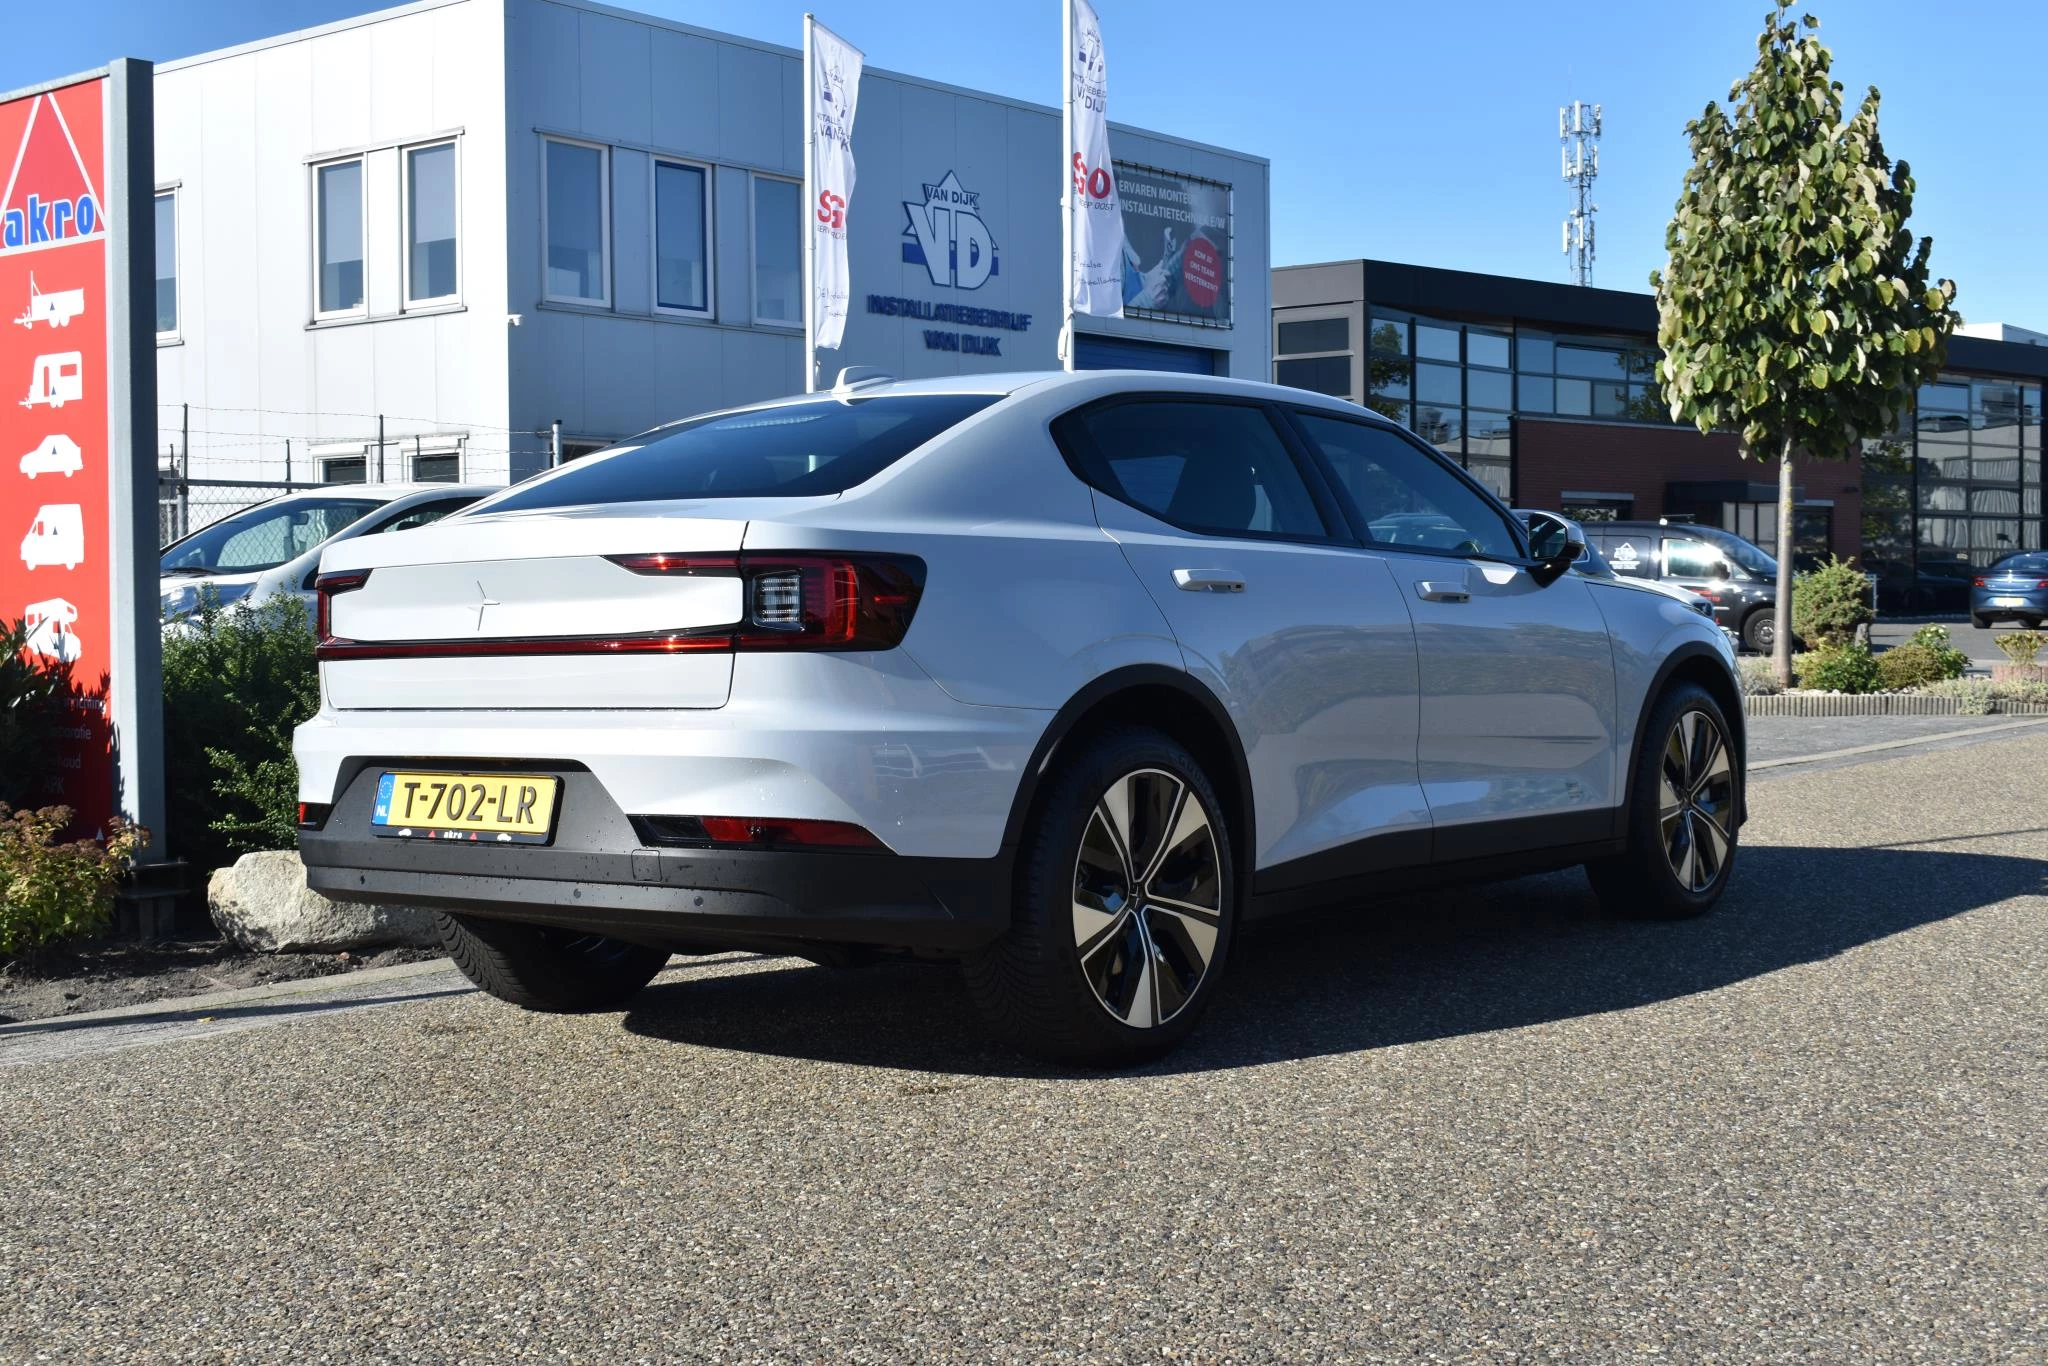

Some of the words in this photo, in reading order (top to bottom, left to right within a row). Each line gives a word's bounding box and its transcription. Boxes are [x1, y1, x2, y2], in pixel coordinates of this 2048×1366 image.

[926, 185, 949, 202] VAN
[951, 191, 978, 206] DIJK
[1118, 180, 1158, 199] ERVAREN
[3, 193, 96, 249] akro
[902, 201, 993, 290] VD
[867, 294, 1032, 332] INSTALLATIEBEDRIJF
[923, 330, 959, 352] VAN
[961, 334, 1002, 357] DIJK
[376, 805, 388, 817] NL
[404, 782, 538, 825] T-702-LR
